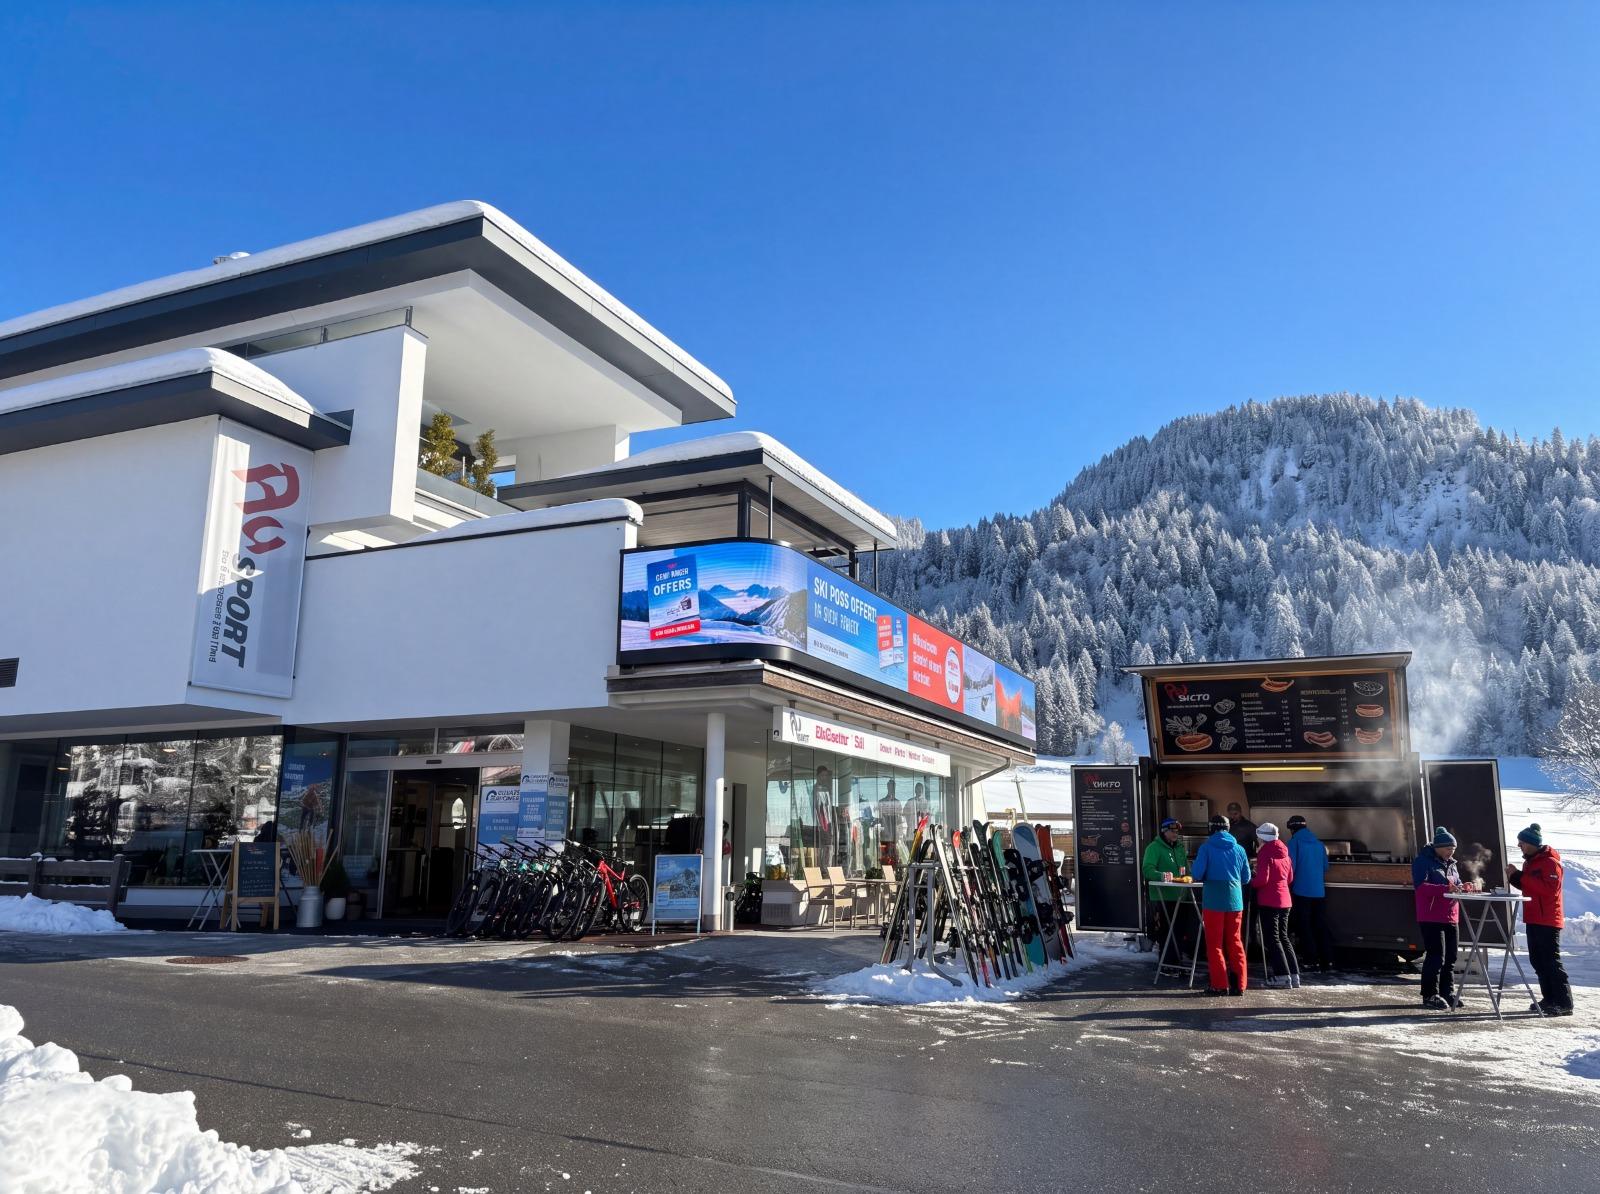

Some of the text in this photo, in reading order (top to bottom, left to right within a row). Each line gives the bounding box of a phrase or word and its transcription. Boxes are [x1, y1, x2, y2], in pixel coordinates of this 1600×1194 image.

[653, 578, 692, 596] OFFERS
[814, 576, 828, 599] SKI
[221, 553, 256, 668] SPORT
